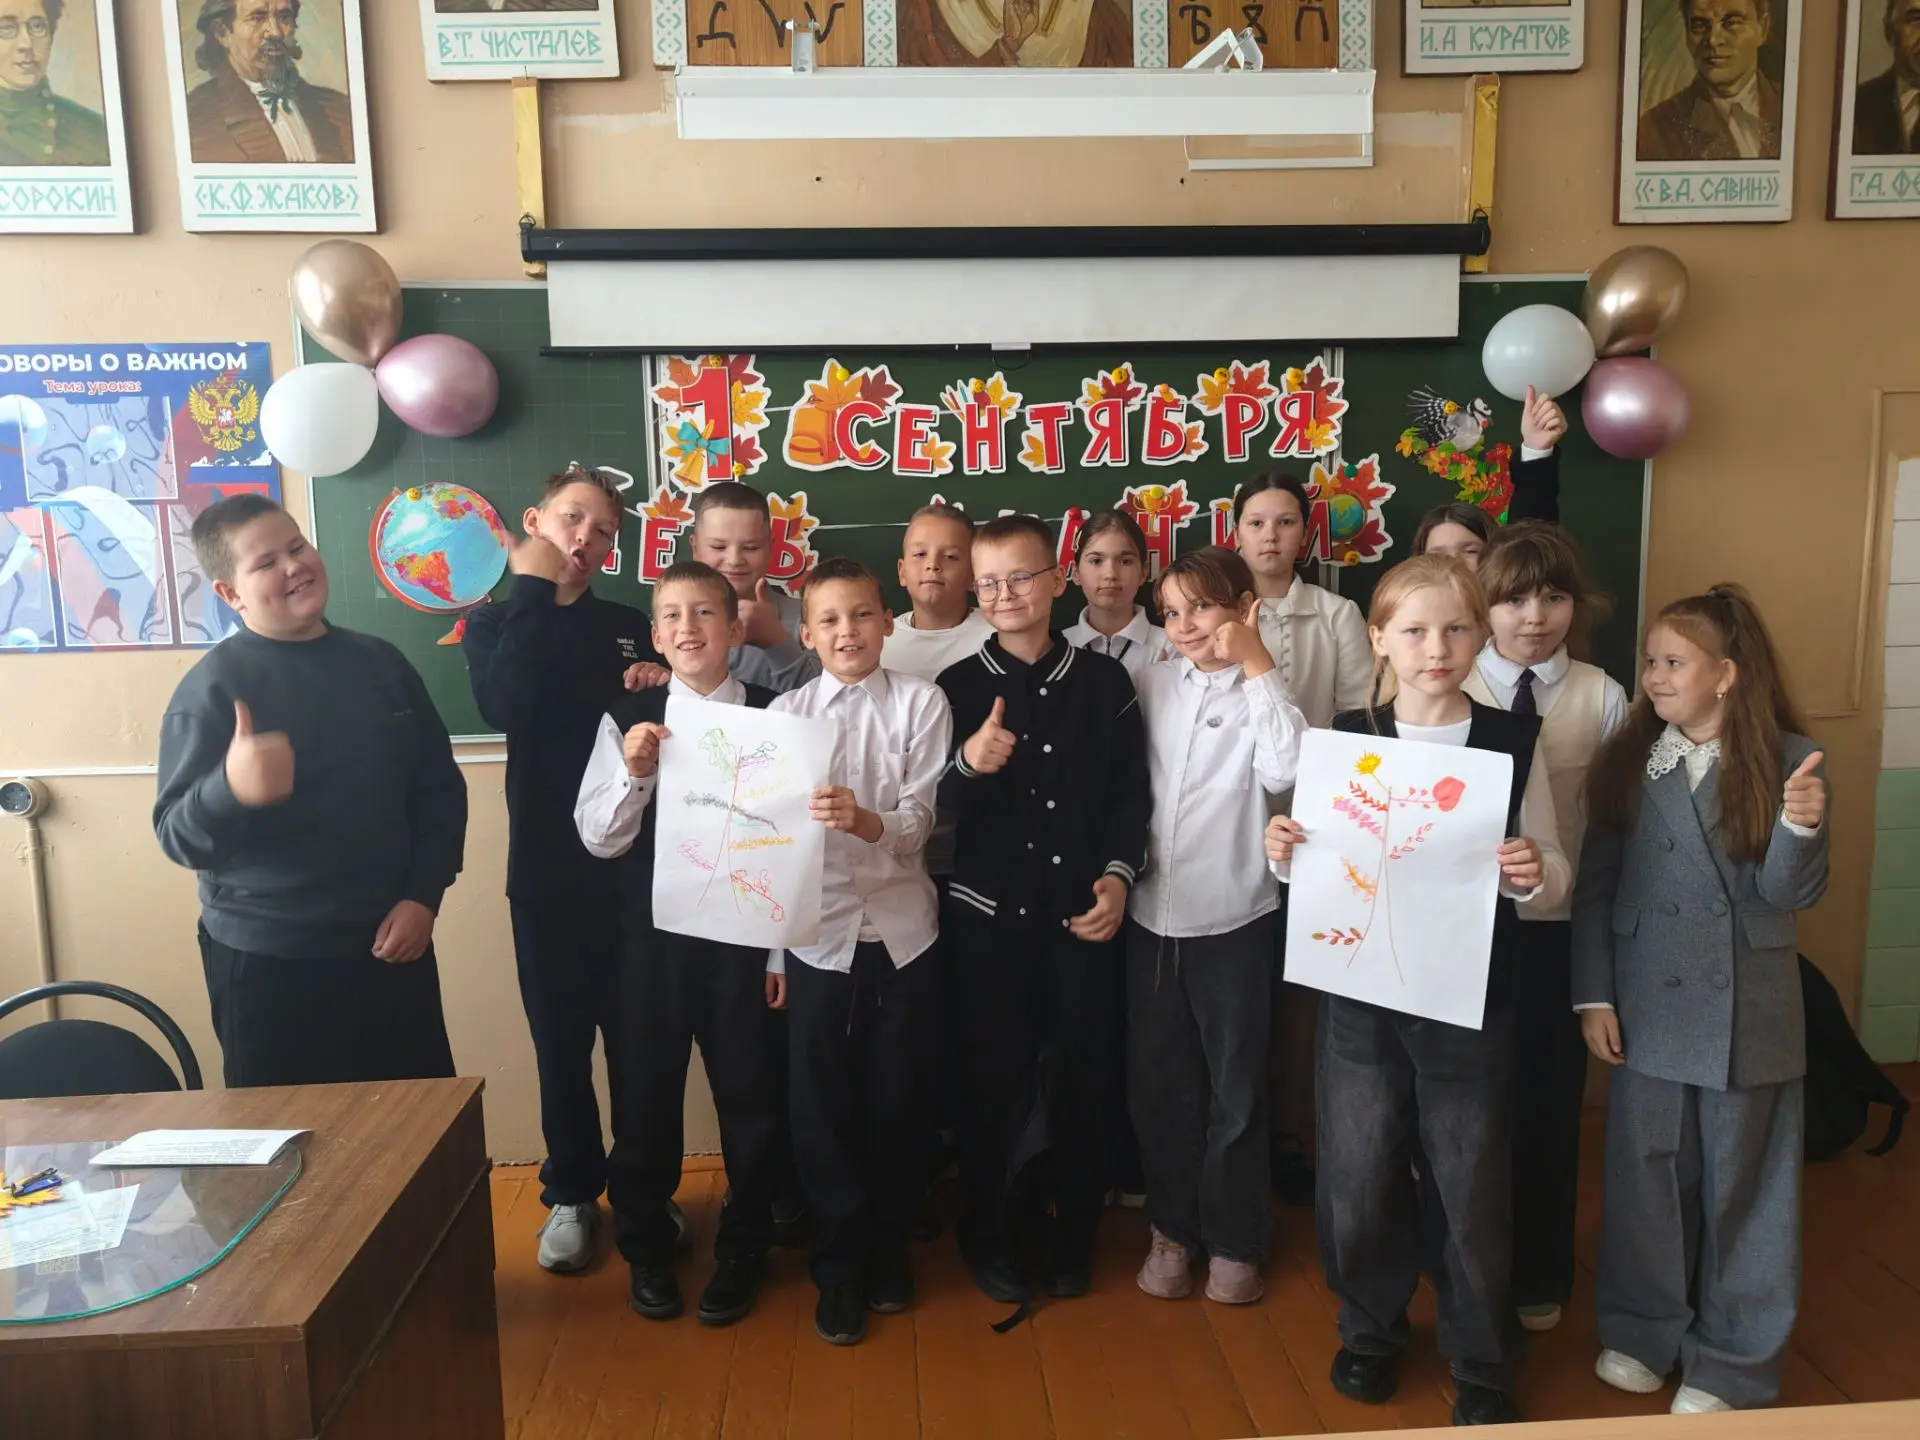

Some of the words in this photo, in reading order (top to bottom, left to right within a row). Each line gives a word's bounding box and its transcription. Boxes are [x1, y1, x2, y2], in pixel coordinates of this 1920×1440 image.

[481, 29, 602, 58] ЧИСТАЛЕВ
[1469, 24, 1571, 51] КУРАТОВ
[99, 352, 120, 372] О
[127, 351, 248, 372] ВАЖНОМ
[43, 379, 86, 393] Тема
[87, 380, 142, 397] урока:
[679, 366, 734, 482] 1
[834, 390, 1316, 472] СЕНТЯБРЯ
